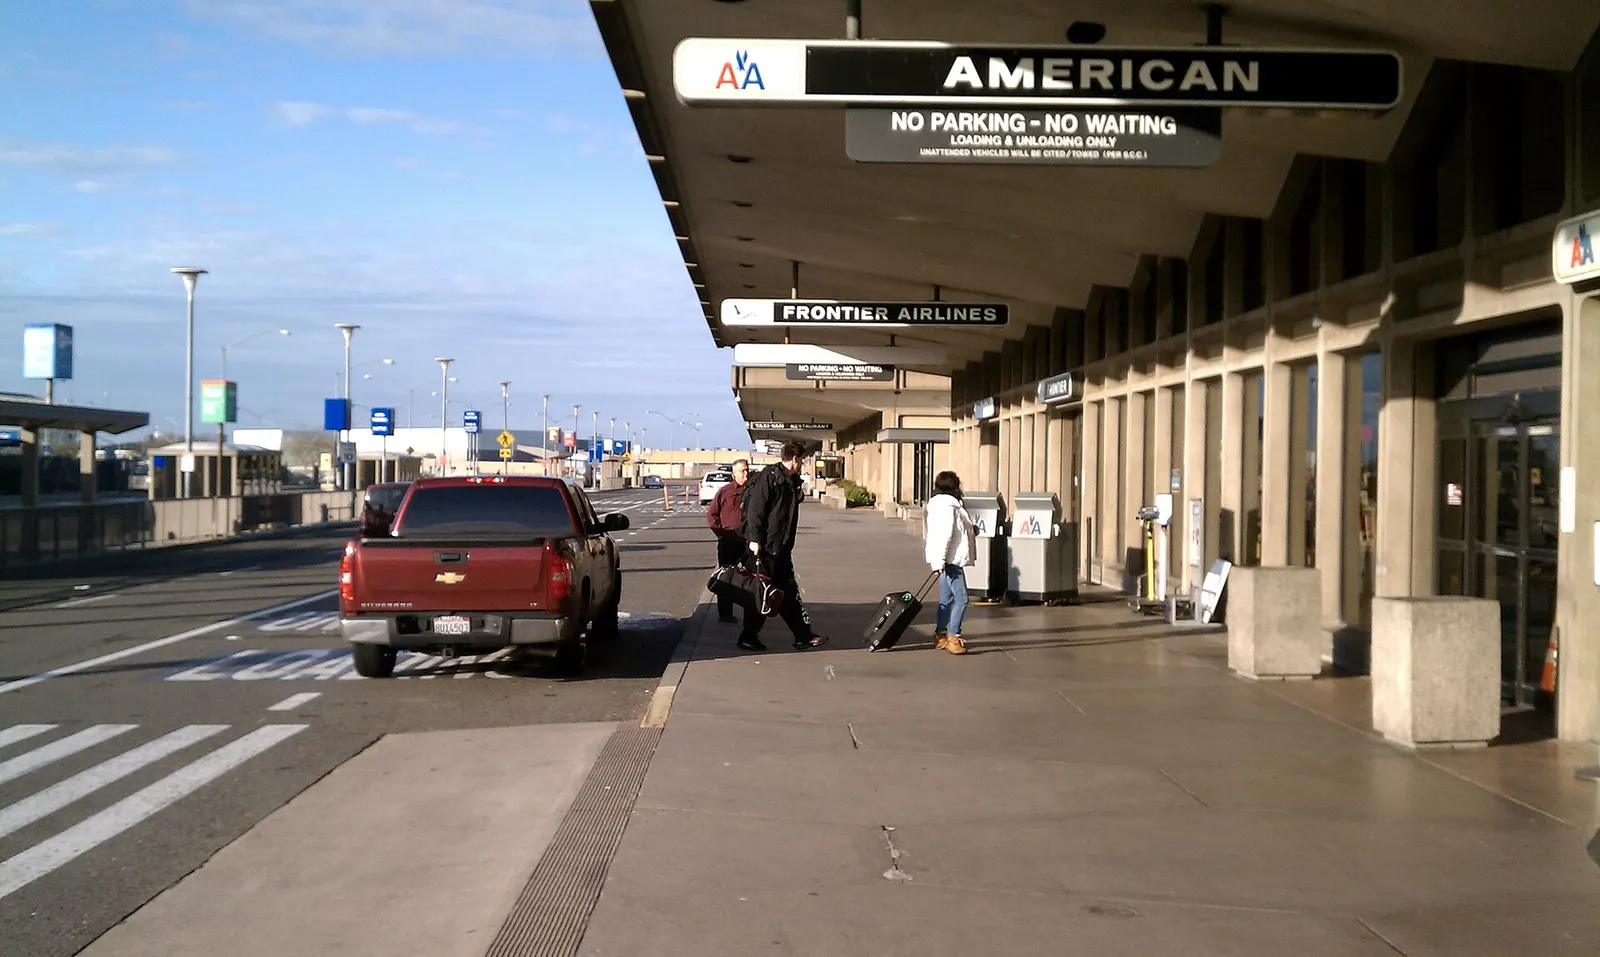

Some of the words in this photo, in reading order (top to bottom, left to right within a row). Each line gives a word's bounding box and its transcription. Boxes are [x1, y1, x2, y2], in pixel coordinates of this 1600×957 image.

[715, 60, 765, 90] AA
[942, 55, 1260, 92] AMERICAN
[891, 111, 925, 131] NO
[930, 111, 1026, 133] PARKING
[1045, 113, 1079, 134] NO
[1085, 113, 1177, 136] WAITING
[950, 134, 1001, 146] LOADING
[1004, 135, 1014, 146] &
[1016, 135, 1083, 148] UNLOADING
[1085, 136, 1117, 148] ONLY
[919, 148, 970, 156] UNATTENDED
[971, 148, 1010, 157] VEHICLES
[1010, 149, 1029, 157] WILL
[1031, 149, 1041, 157] BE
[1043, 149, 1100, 159] CITED/TOWED
[783, 305, 888, 321] FRONTIER
[898, 306, 997, 322] AIRLINES
[798, 364, 809, 372] NO
[810, 364, 838, 372] PARKING
[855, 365, 882, 373] WAITING
